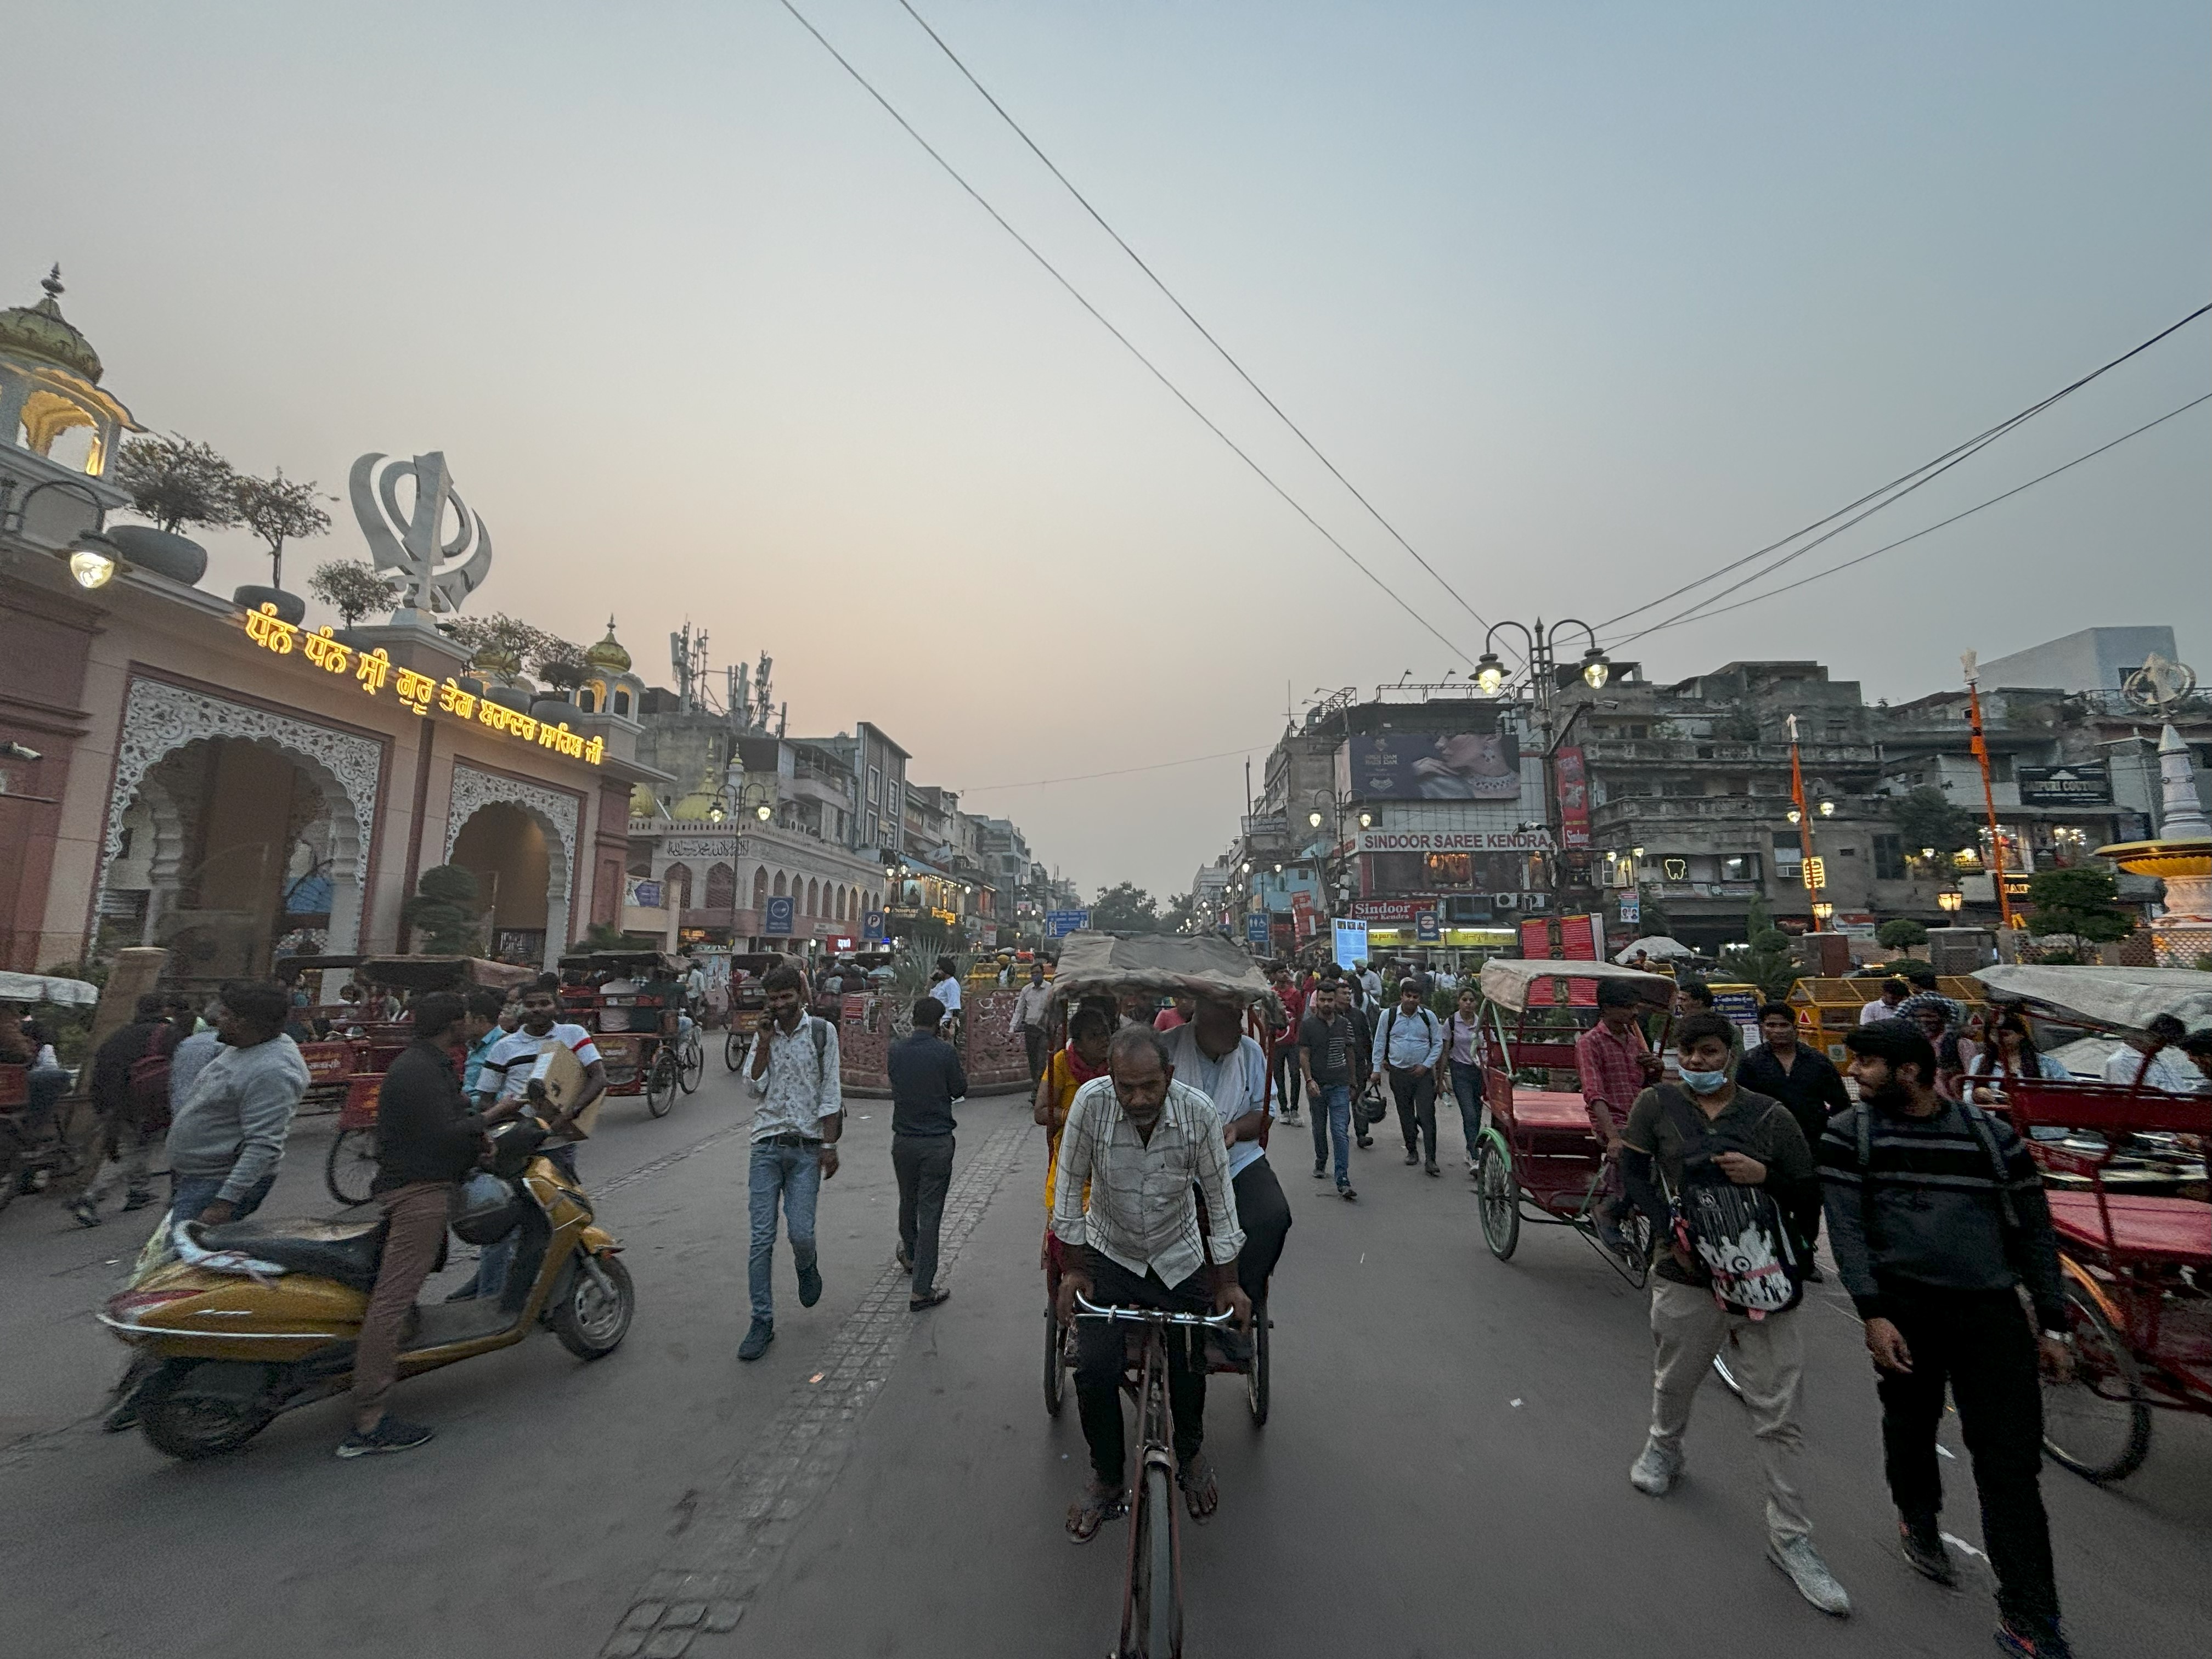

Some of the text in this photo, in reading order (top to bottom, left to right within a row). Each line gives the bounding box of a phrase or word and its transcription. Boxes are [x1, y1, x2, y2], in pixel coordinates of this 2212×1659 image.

[246, 602, 298, 654] ਧੰਨ
[304, 625, 352, 674] ਧੰਨ
[396, 667, 437, 715] ਗੁਰੂ
[439, 677, 476, 720] ਤੇਗ
[478, 698, 538, 741] ਬਹਾਦਰ
[538, 722, 585, 758] ਸਾਹਿਬ
[585, 736, 603, 765] ਜੀ
[1364, 834, 1431, 849] SINDOOR
[1434, 834, 1483, 849] SAREE
[1487, 834, 1548, 848] KENDRA
[1355, 902, 1410, 914] Sindoor
[871, 916, 878, 926] P
